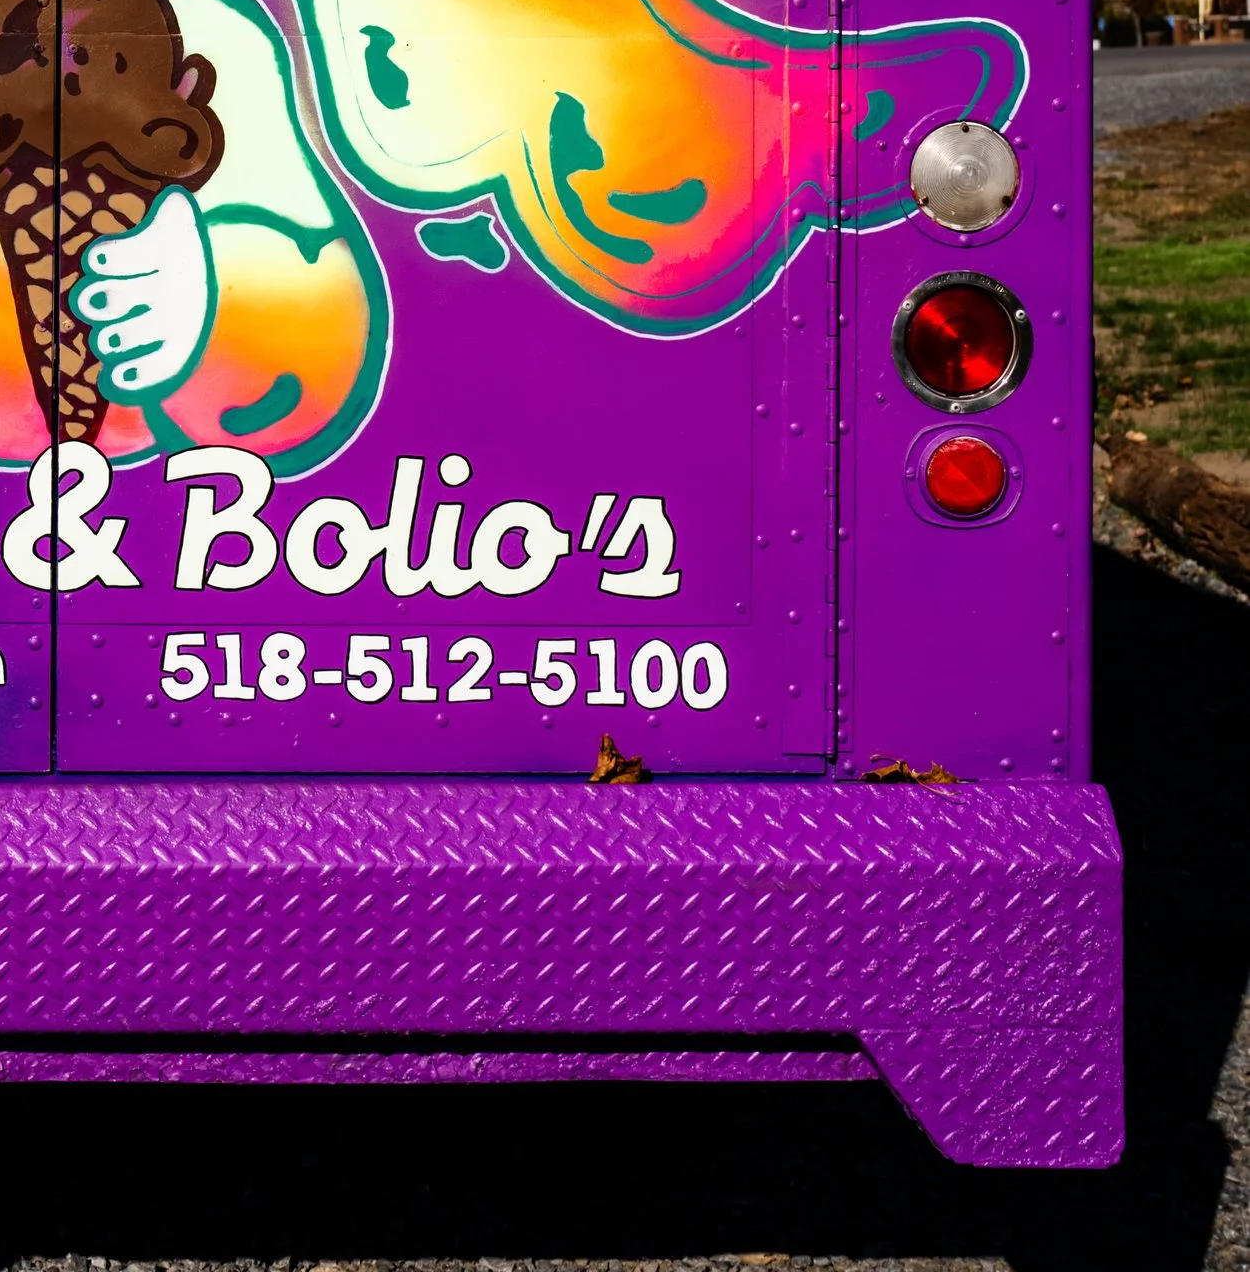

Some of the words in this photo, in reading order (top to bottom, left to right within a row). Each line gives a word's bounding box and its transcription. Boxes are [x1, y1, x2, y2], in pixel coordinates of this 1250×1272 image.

[1, 440, 143, 592] &
[163, 444, 682, 598] Bolio's
[159, 632, 729, 710] 518-512-5100
